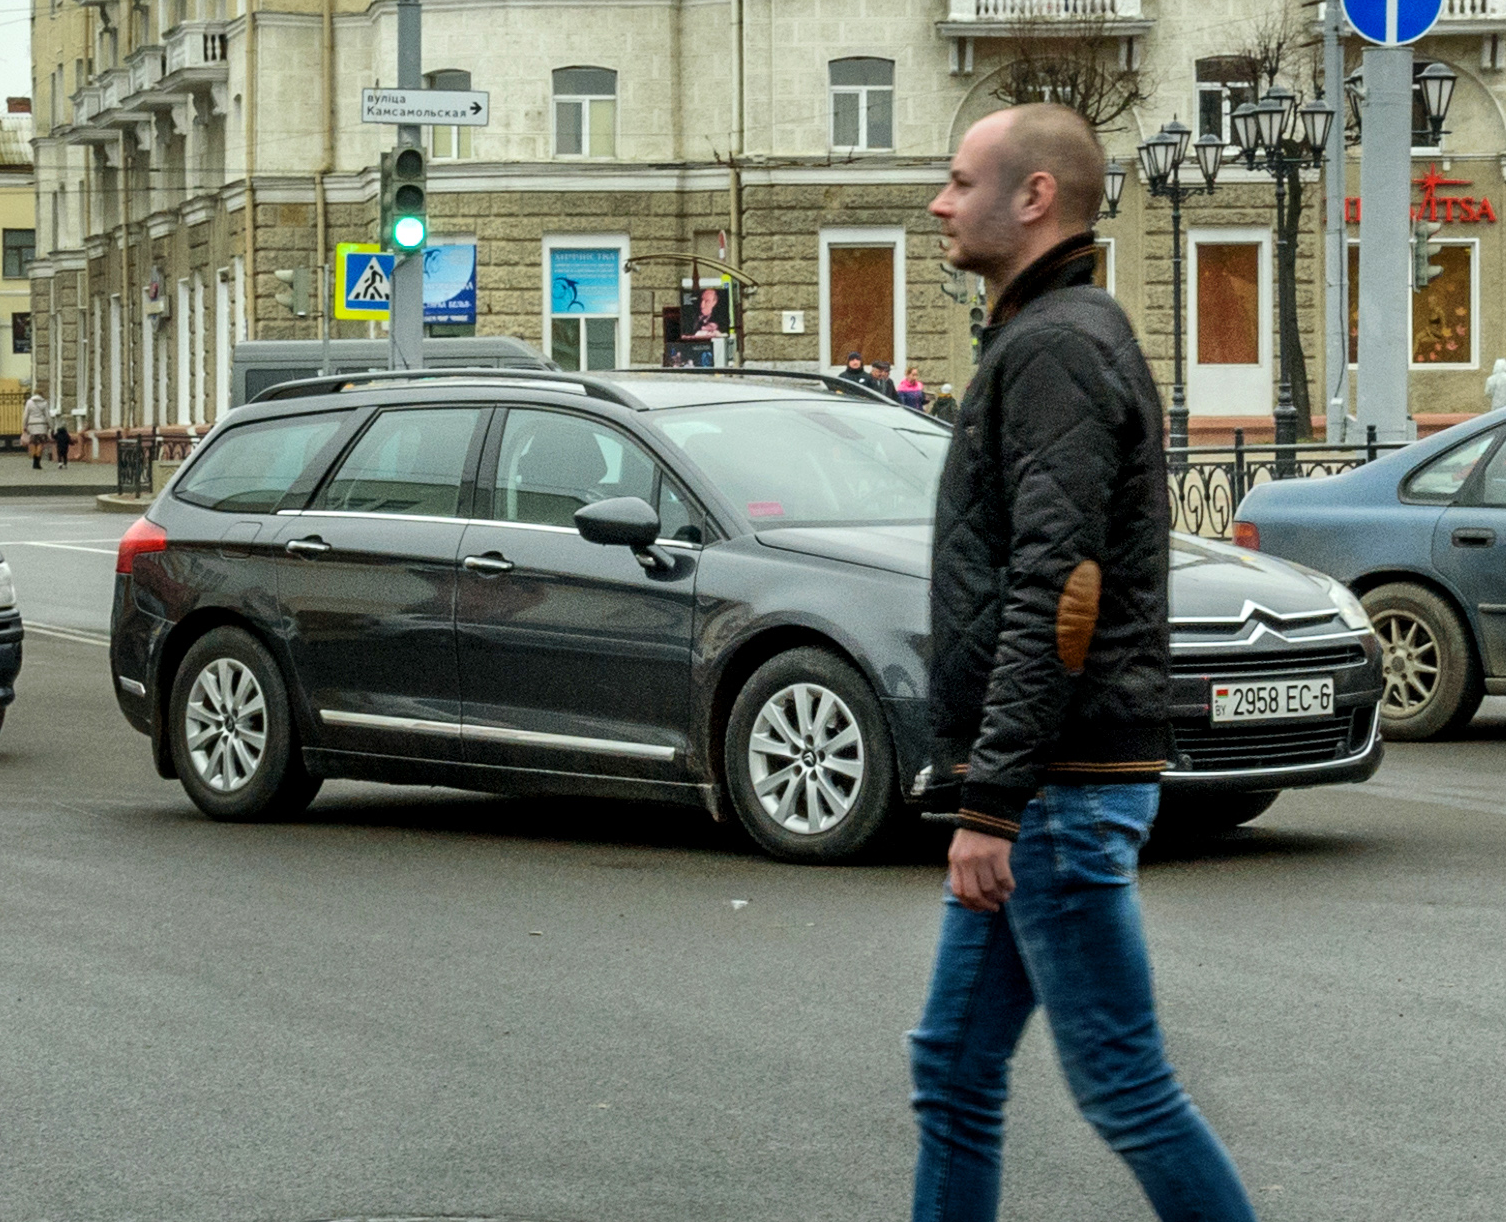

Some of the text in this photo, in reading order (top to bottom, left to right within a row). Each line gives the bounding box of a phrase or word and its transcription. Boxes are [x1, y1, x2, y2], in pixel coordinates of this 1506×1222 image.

[367, 95, 406, 104] вуліца
[367, 106, 467, 118] Камсамольская
[789, 316, 796, 330] 2
[1233, 683, 1331, 717] 2958 EC-6
